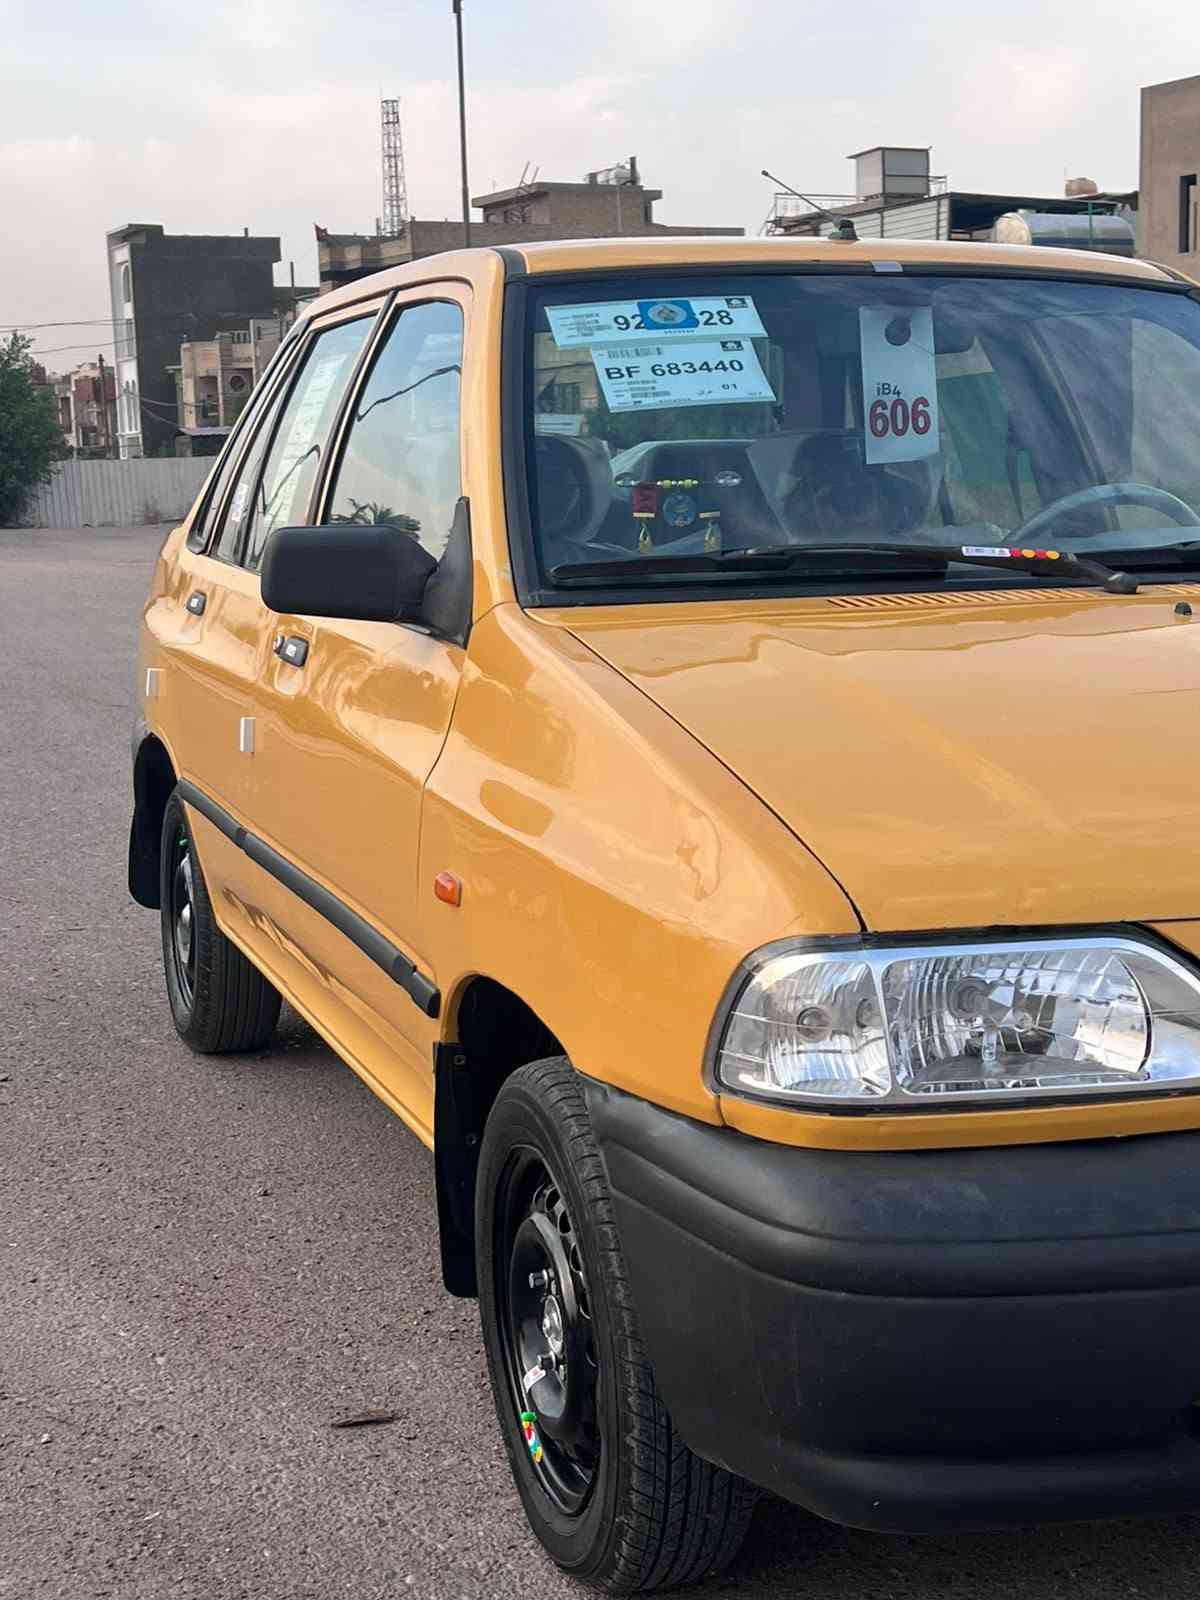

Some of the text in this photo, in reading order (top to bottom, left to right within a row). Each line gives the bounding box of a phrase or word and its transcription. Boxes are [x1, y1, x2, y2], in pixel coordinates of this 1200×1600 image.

[604, 359, 744, 380] BF 683440
[869, 396, 931, 438] 606
